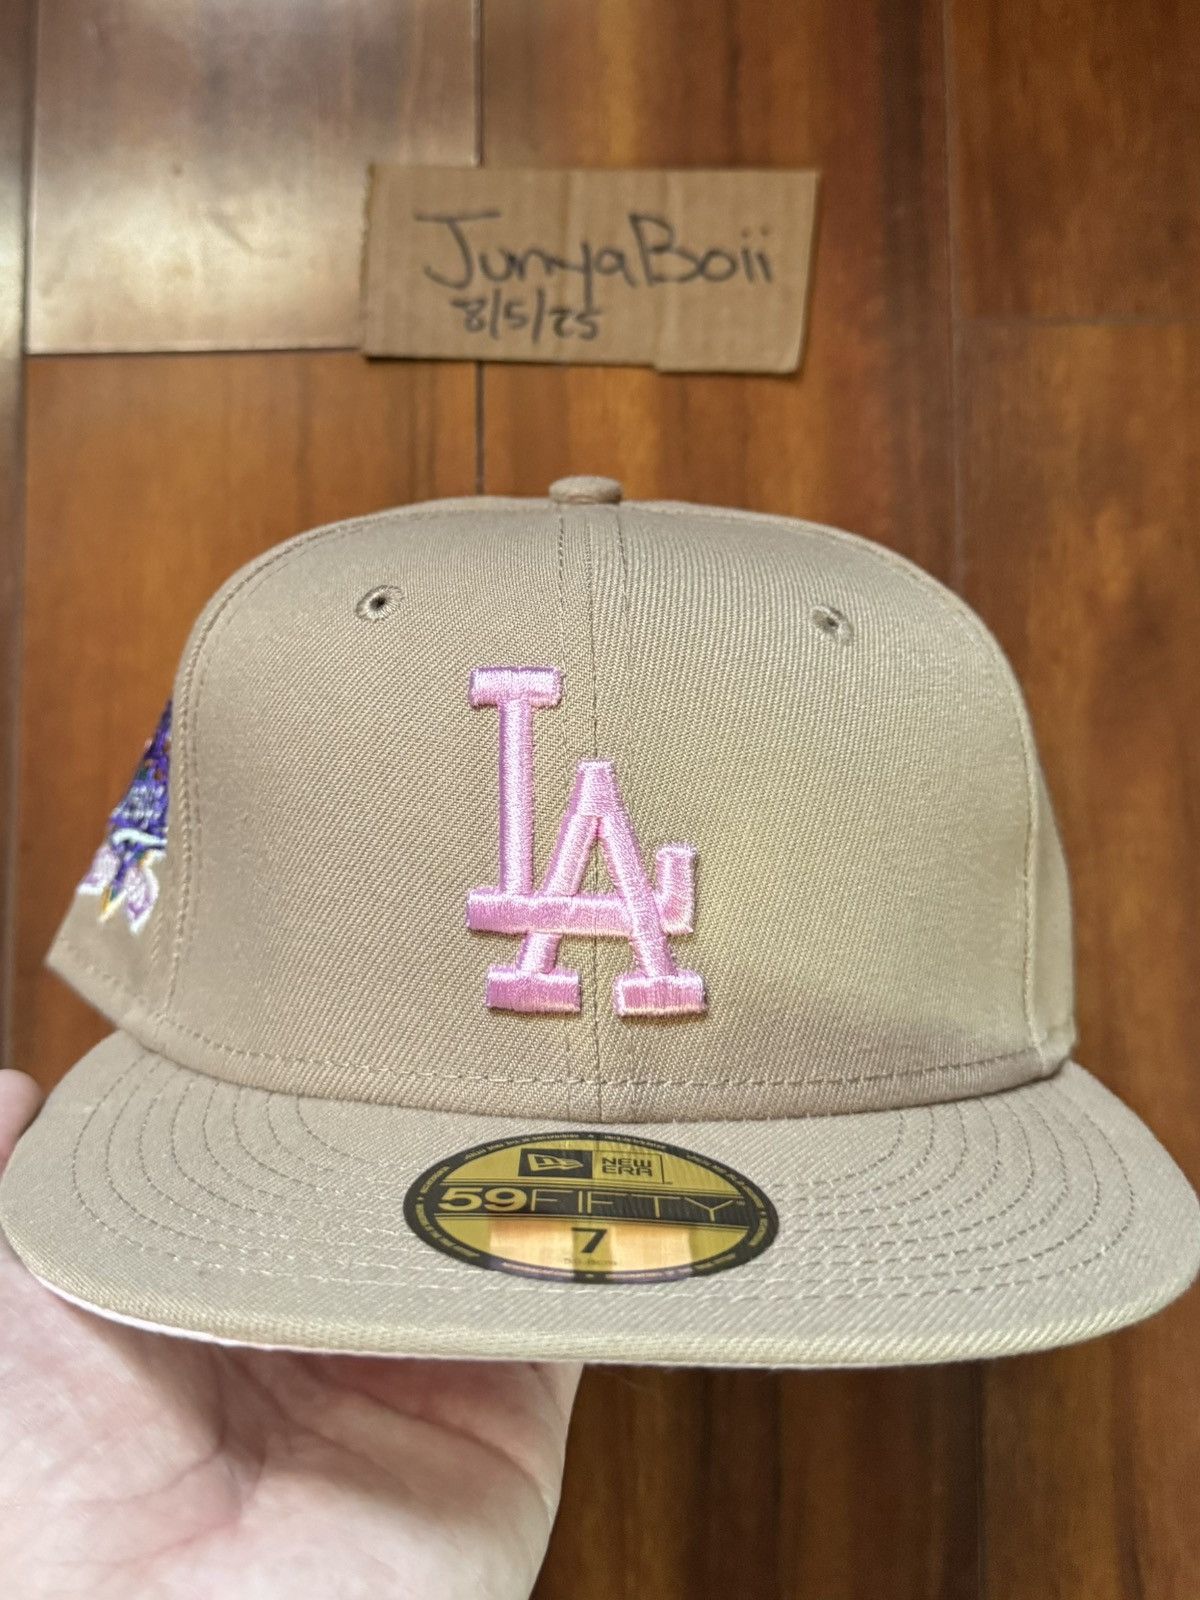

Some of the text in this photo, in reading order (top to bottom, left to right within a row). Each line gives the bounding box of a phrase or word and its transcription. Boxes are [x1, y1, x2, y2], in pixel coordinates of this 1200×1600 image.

[451, 288, 603, 343] 8/5/25
[466, 666, 707, 1017] LA
[601, 1157, 652, 1167] NEW
[601, 1166, 653, 1177] ERA
[437, 1186, 735, 1222] 59FIFTY
[571, 1226, 608, 1254] 7
